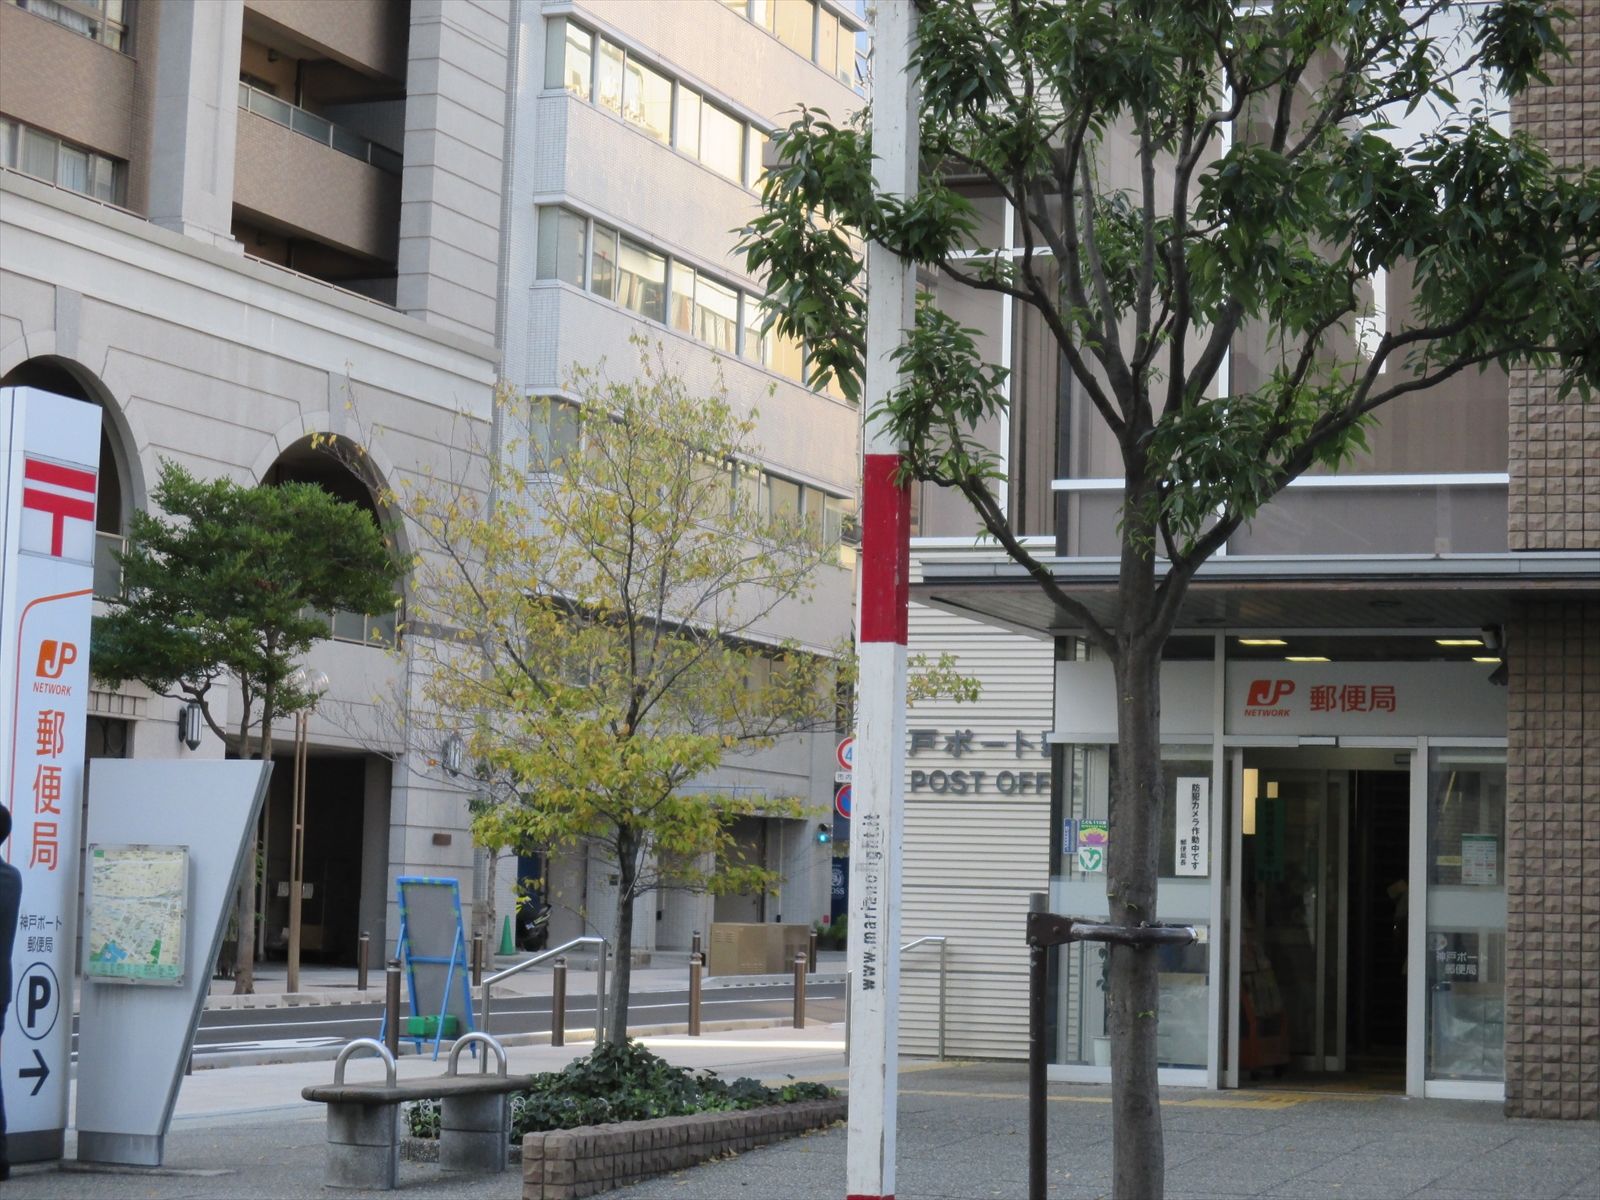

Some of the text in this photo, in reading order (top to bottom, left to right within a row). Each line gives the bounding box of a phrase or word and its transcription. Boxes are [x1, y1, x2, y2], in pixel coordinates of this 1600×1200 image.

[32, 681, 72, 697] NETWORK
[1309, 685, 1396, 713] 郵便局
[1244, 709, 1291, 717] NETWORK
[29, 709, 65, 871] 郵便局
[911, 769, 1051, 795] POST OFF
[1191, 783, 1200, 870] 防犯カメラ作動中です
[27, 936, 54, 953] 郵便局
[27, 975, 51, 1029] P
